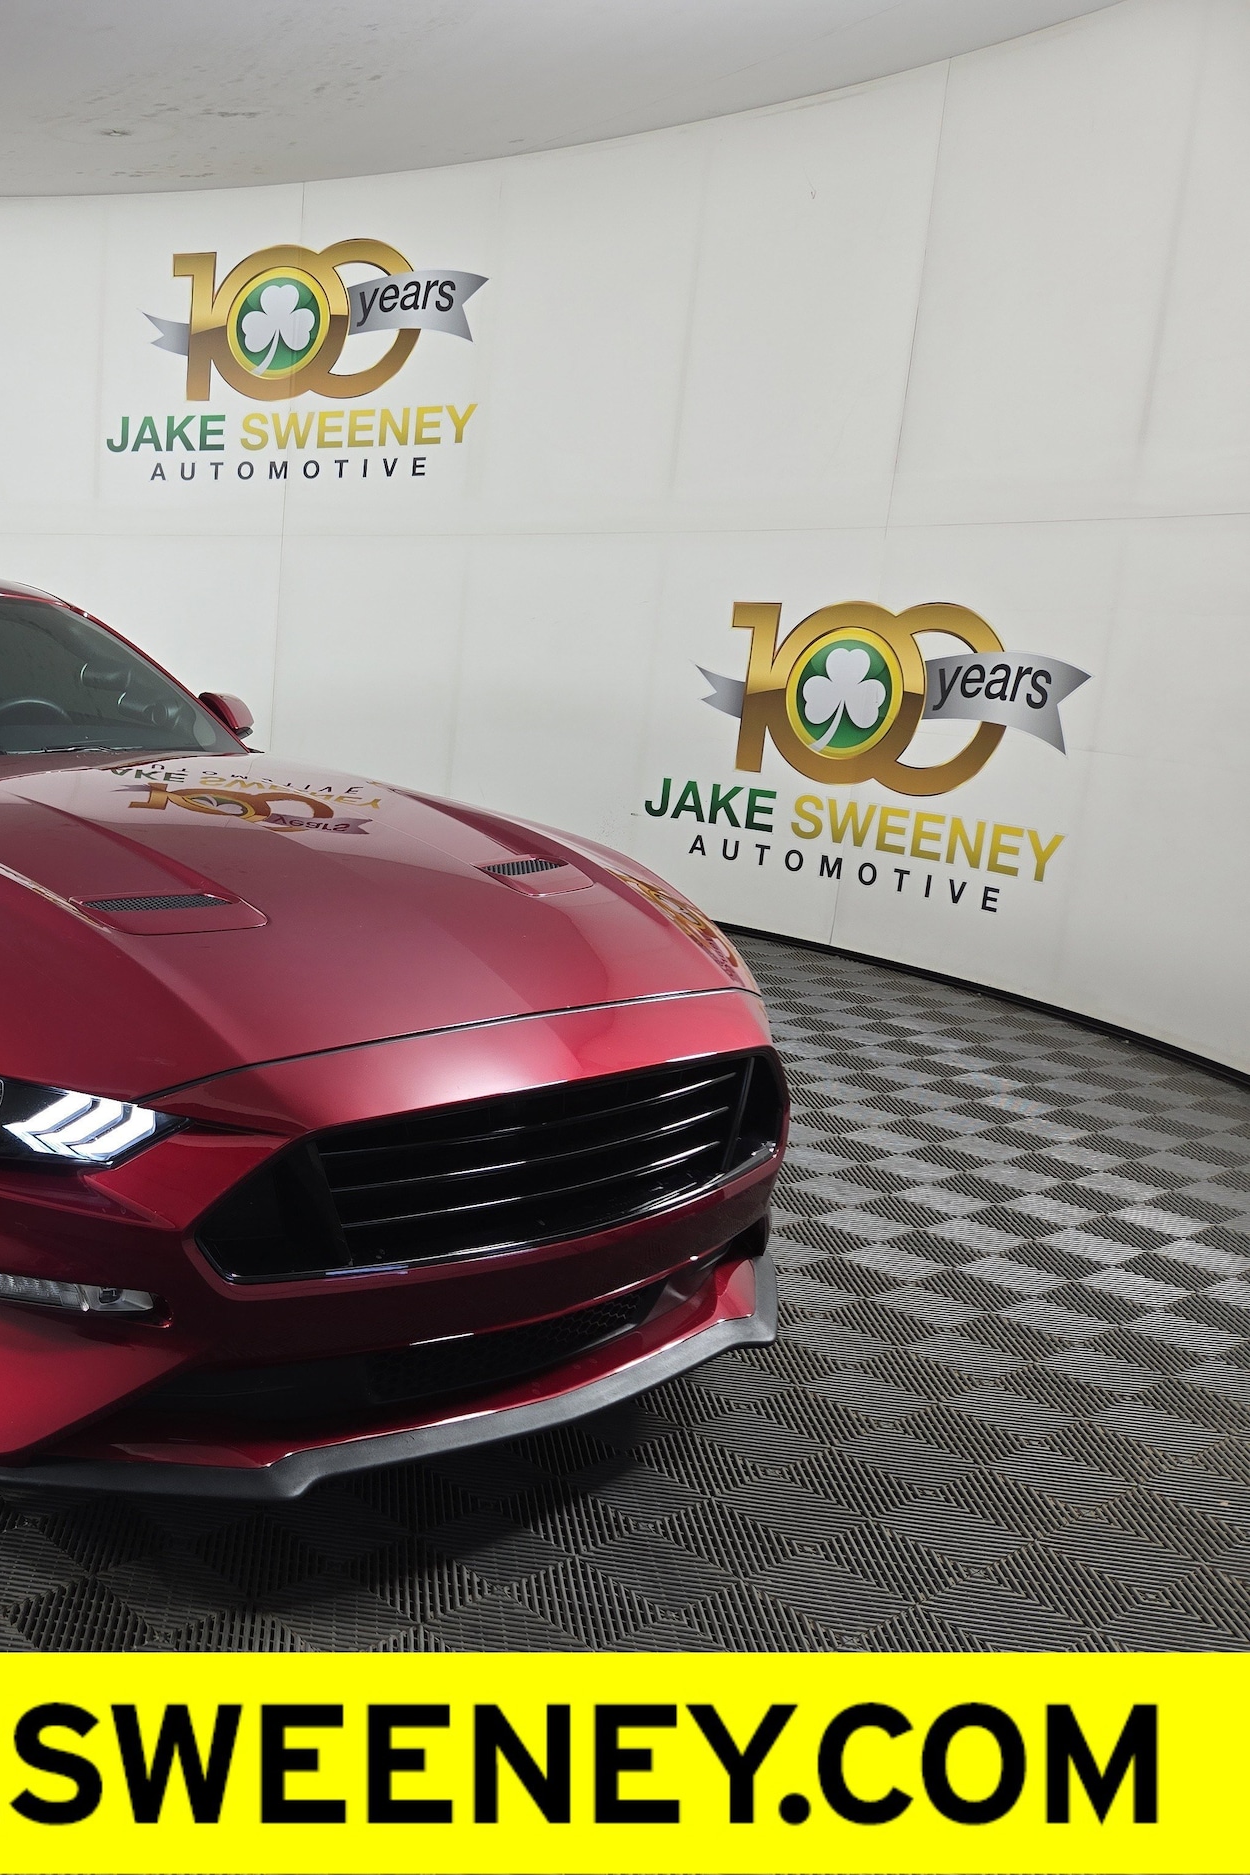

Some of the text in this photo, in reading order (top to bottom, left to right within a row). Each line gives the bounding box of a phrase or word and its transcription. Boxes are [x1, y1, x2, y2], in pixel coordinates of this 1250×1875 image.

[173, 238, 456, 401] 100 years
[106, 403, 478, 452] JAKE SWEENEY
[150, 456, 427, 481] AUTOMOTIVE
[731, 601, 1052, 796] 100 years
[645, 778, 1065, 882] JAKE SWEENEY
[688, 834, 1000, 912] AUTOMOTIVE
